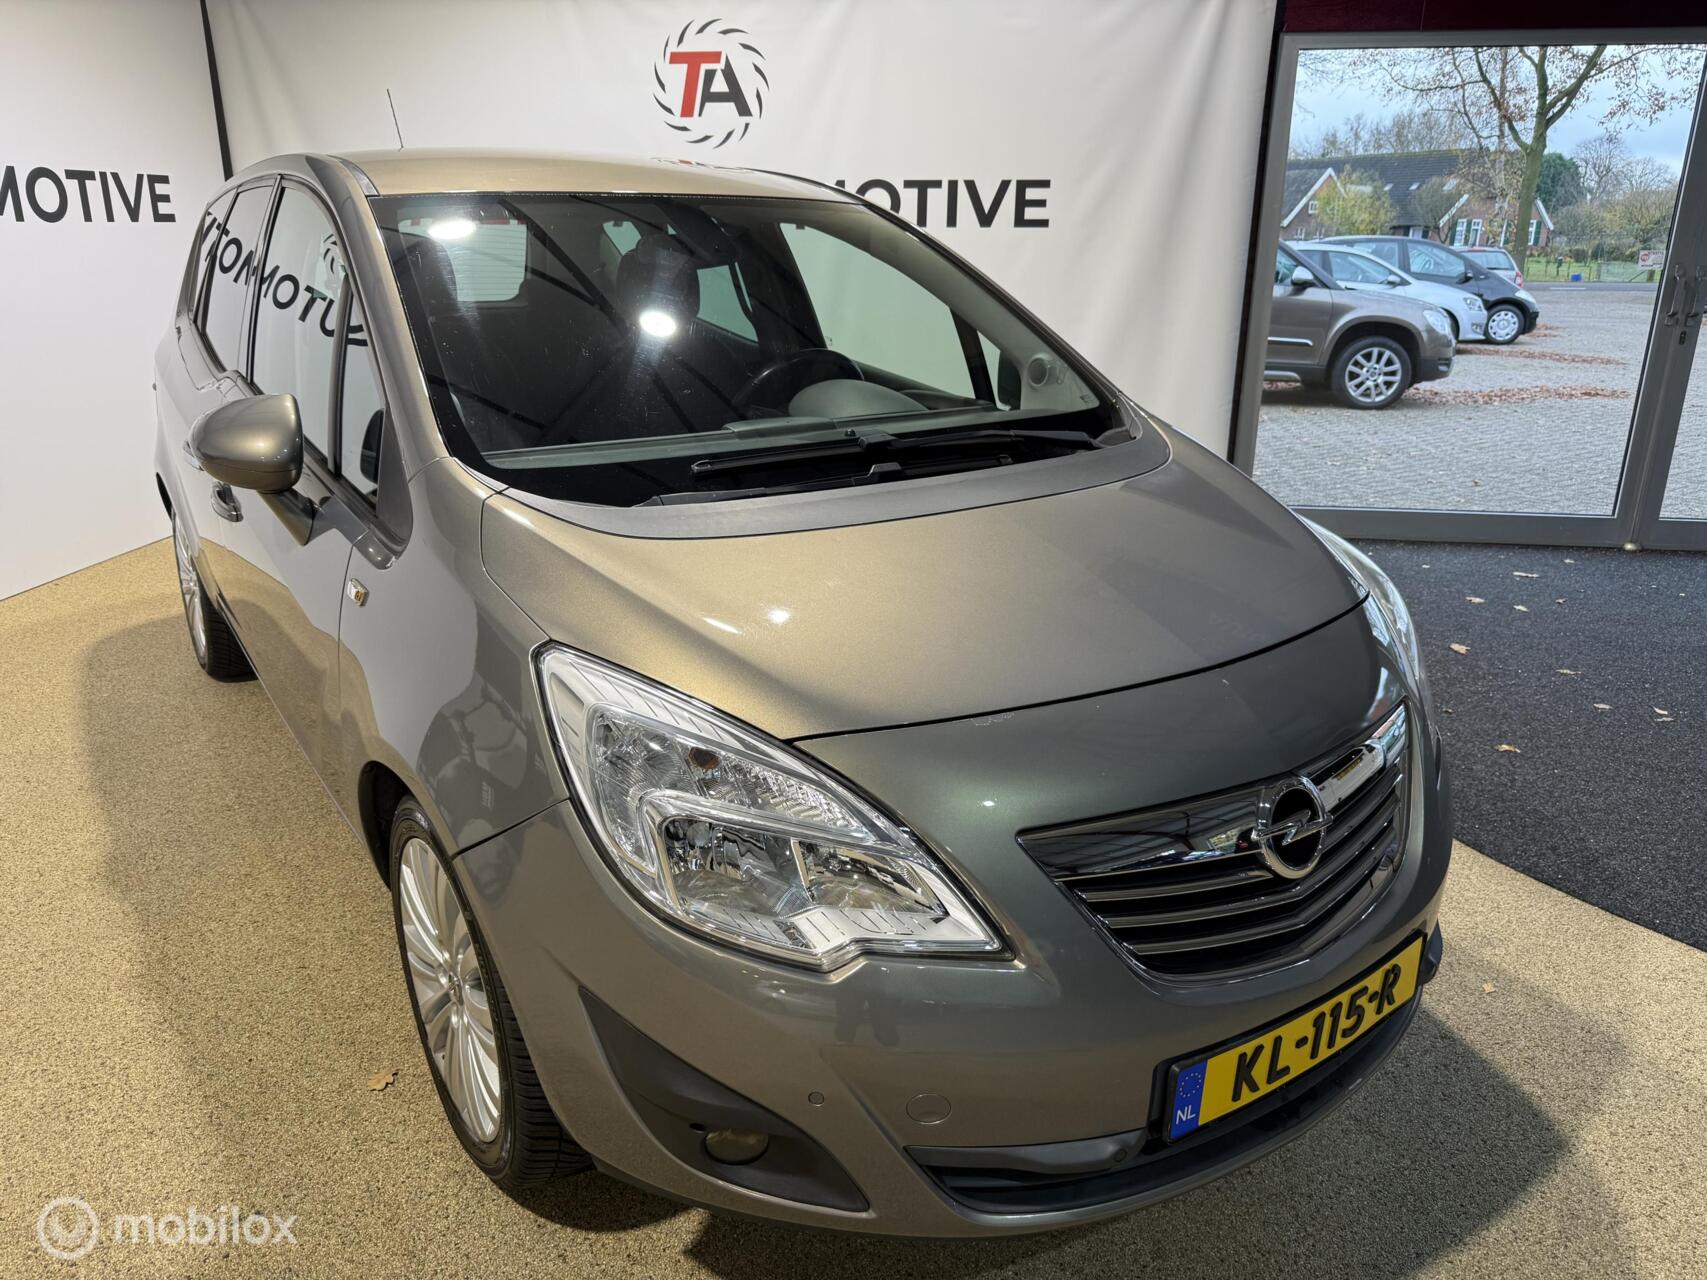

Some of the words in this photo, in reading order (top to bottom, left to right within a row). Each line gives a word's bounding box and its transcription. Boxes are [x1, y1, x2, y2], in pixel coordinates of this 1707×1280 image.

[669, 50, 753, 118] TA
[835, 178, 1051, 228] OTIVE
[1231, 963, 1401, 1102] KL-115-R
[1175, 1104, 1196, 1124] NL
